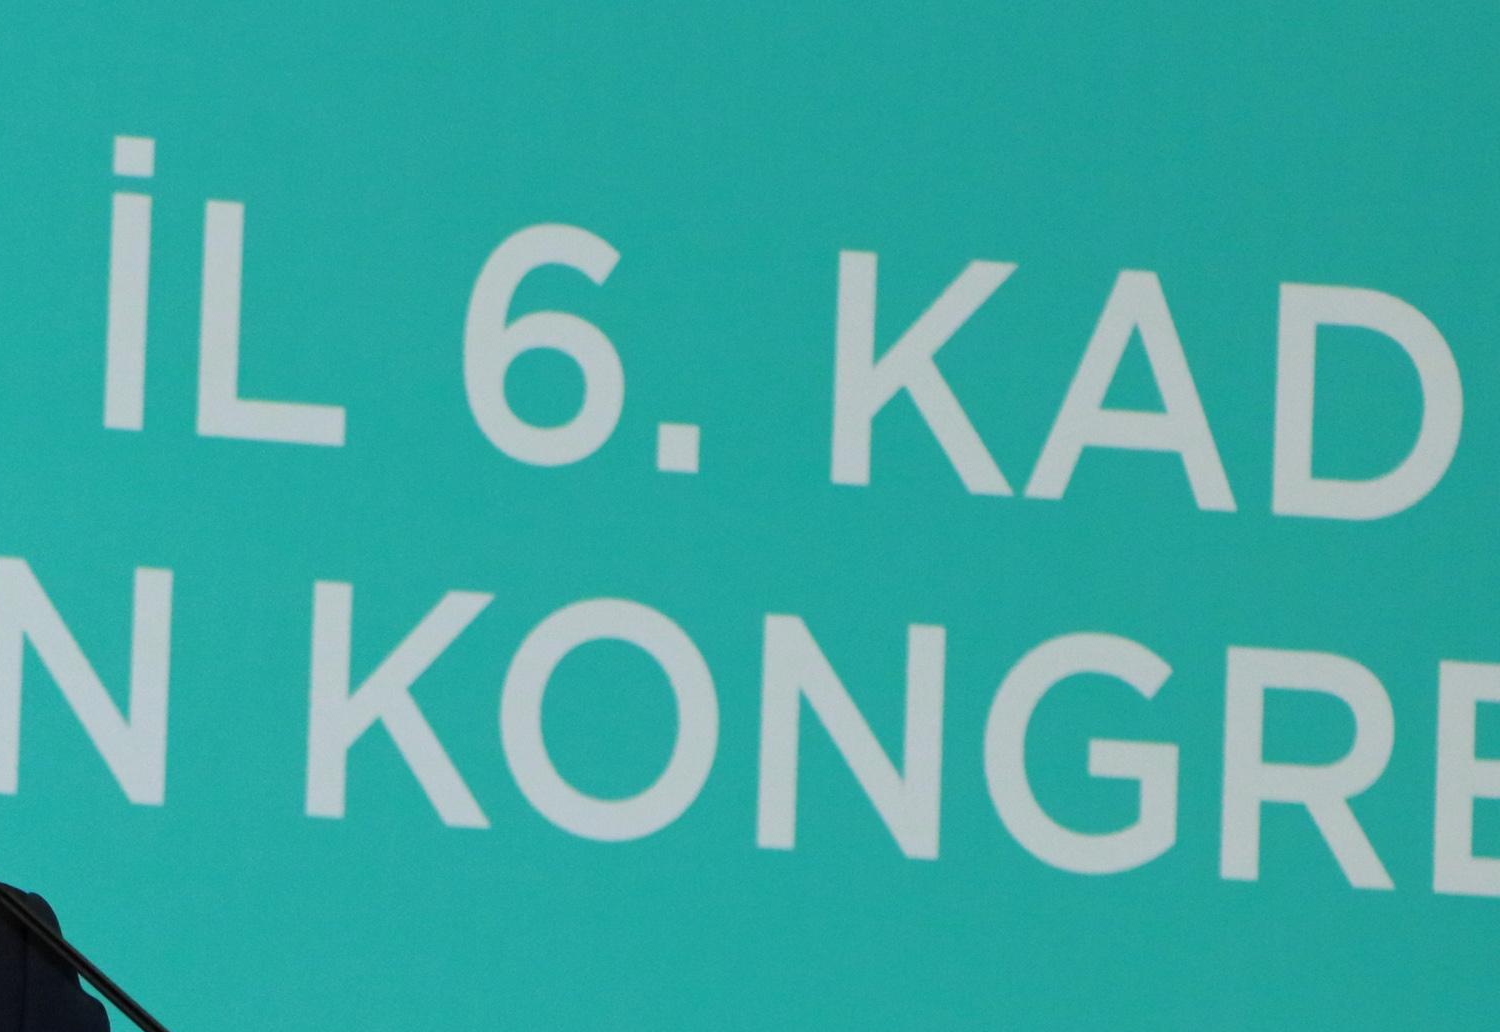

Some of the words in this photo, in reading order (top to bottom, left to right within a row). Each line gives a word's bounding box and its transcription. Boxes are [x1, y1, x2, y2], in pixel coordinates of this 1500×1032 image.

[103, 134, 346, 447] İL
[463, 222, 701, 474] 6.
[830, 249, 1464, 521] KAD
